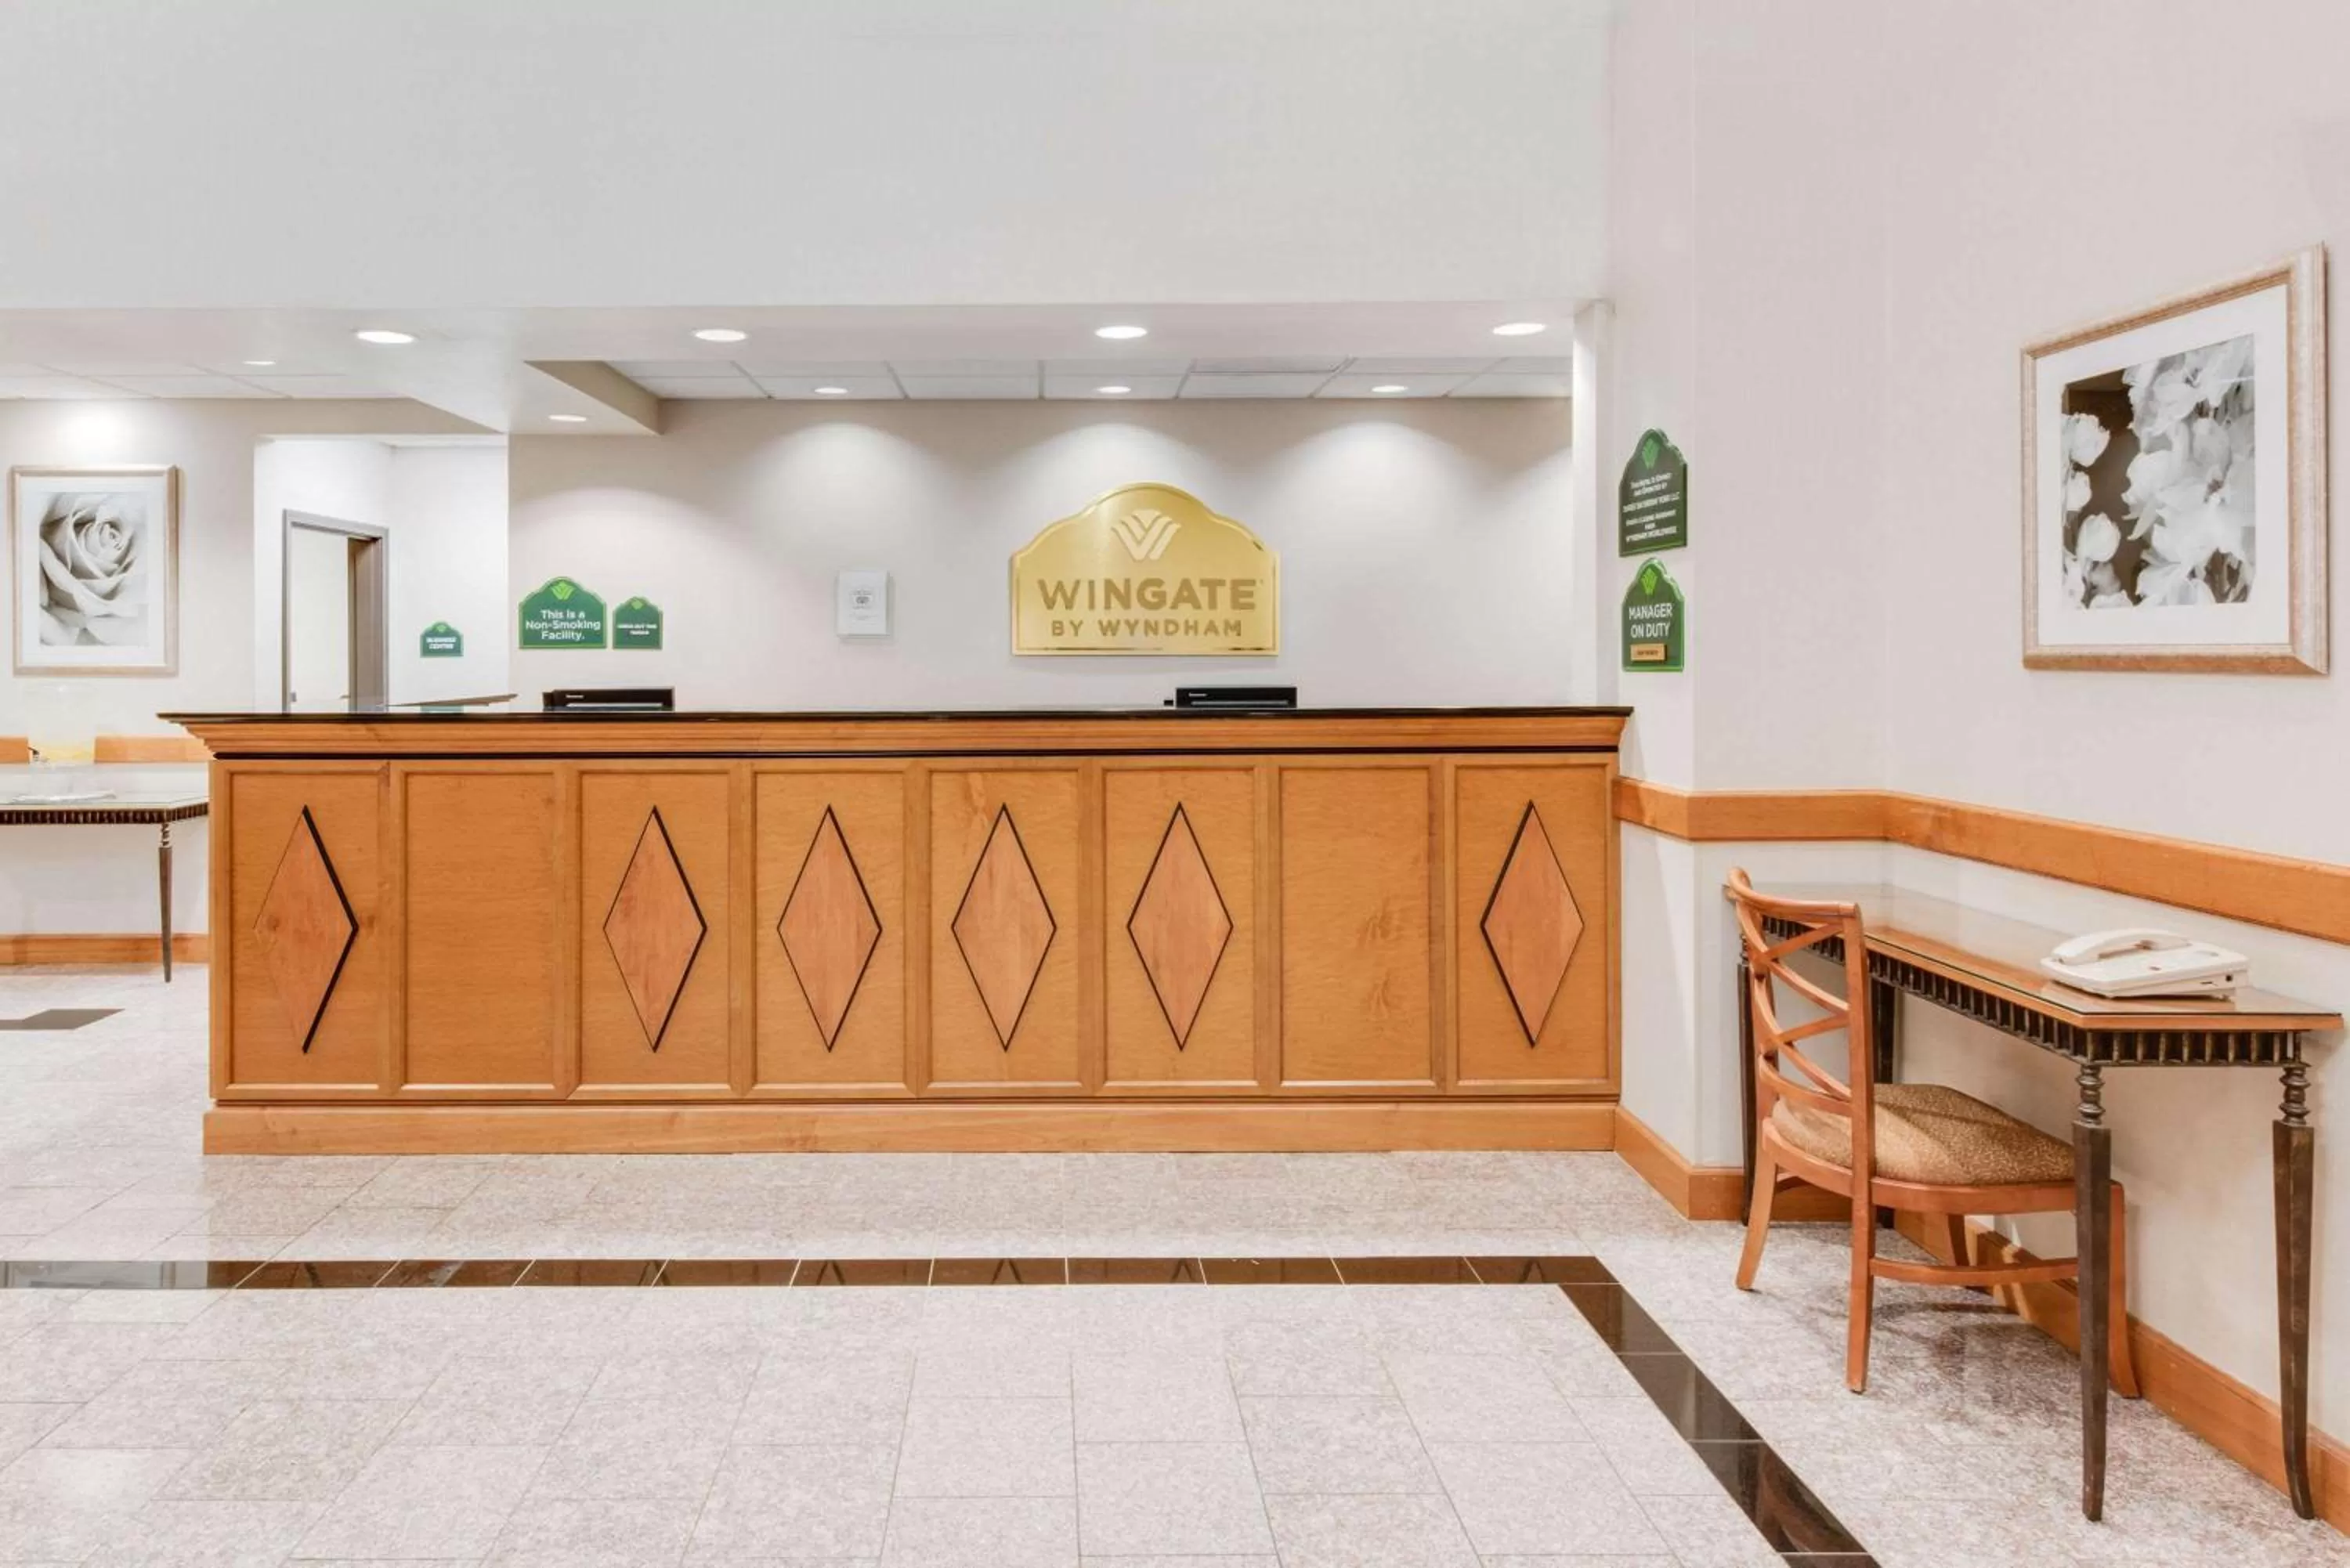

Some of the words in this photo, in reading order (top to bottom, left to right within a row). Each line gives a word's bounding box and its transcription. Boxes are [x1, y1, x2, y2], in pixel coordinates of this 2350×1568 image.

[1037, 577, 1256, 610] WINGATE
[540, 609, 564, 619] This
[566, 609, 576, 619] is
[1629, 603, 1673, 620] MANAGER
[526, 620, 601, 631] Non-Smoking
[1051, 620, 1083, 637] BY
[1099, 620, 1242, 637] WYNDHAM
[1630, 623, 1644, 638] ON
[1646, 622, 1671, 638] DUTY
[541, 630, 585, 642] Facility.
